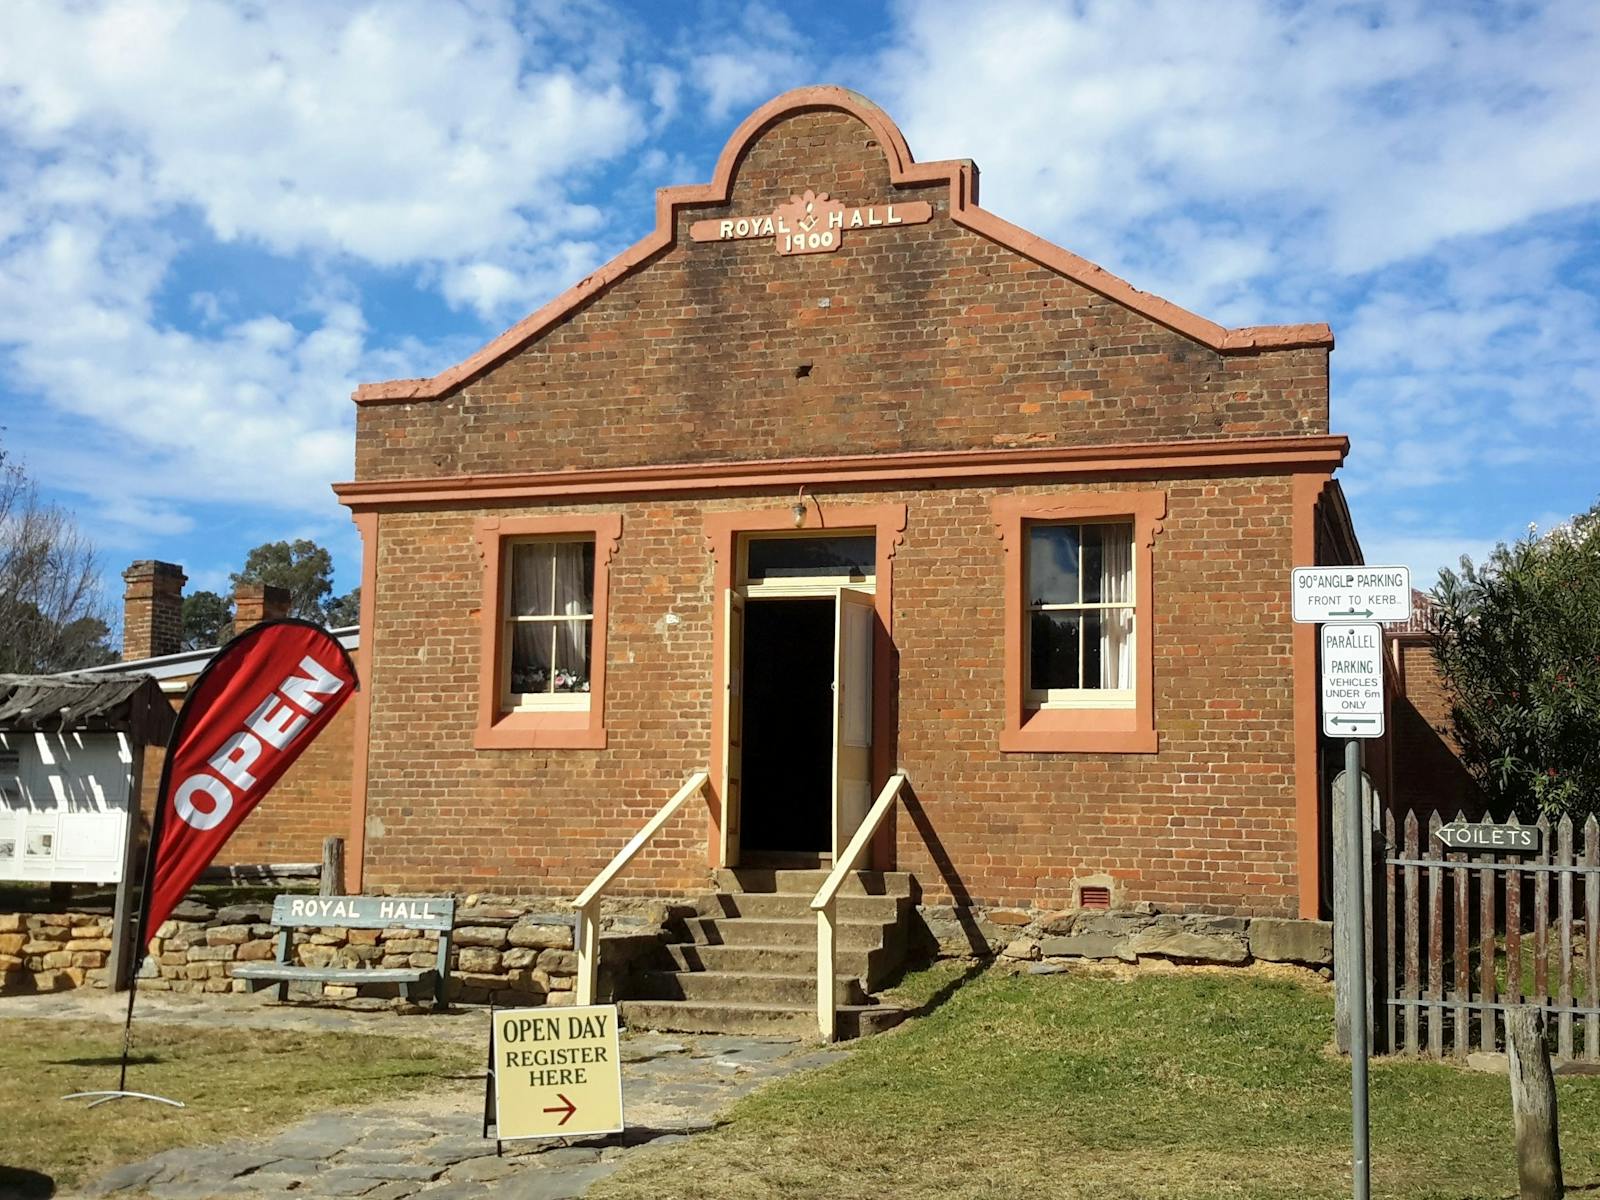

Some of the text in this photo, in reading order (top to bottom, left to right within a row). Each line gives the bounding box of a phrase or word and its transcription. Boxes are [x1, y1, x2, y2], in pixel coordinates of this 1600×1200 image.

[720, 206, 903, 238] ROYAL HALL
[785, 231, 833, 252] 1900
[1357, 573, 1403, 587] PARKING
[1308, 595, 1341, 605] FRONT
[1349, 595, 1361, 605] TO
[1326, 635, 1376, 649] PARALLEL
[1331, 660, 1373, 674] PARKING
[1329, 678, 1378, 687] VEHICLES
[1325, 689, 1380, 698] UNDER 6m
[1341, 701, 1366, 710] ONLY
[174, 655, 345, 831] OPEN
[1442, 828, 1531, 845] TOILETS
[291, 899, 436, 920] ROYAL HALL
[503, 1015, 608, 1043] OPEN DAY
[506, 1046, 608, 1068] REGISTER
[529, 1068, 588, 1087] HERE
